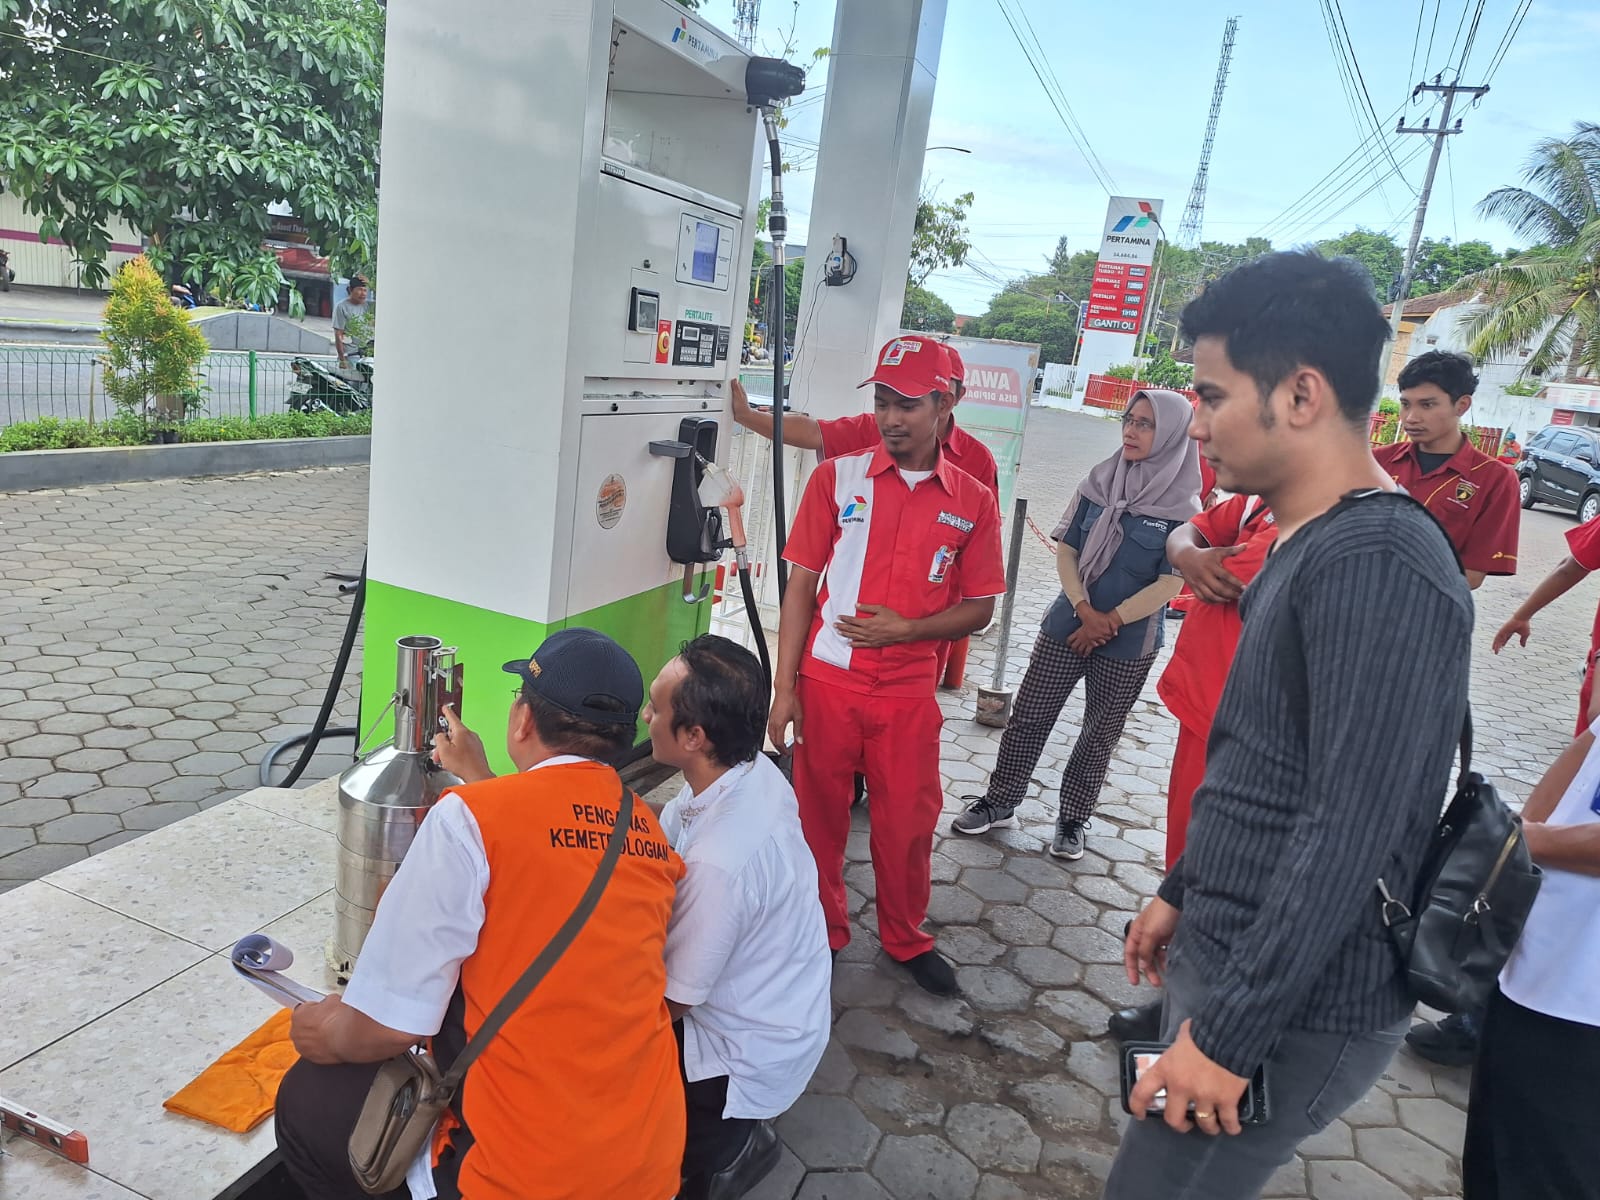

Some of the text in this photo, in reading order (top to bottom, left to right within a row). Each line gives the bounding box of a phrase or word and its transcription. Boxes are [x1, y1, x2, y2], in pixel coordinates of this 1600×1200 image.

[1106, 235, 1151, 246] PERTAMINA
[685, 309, 713, 321] PERTALITE
[1095, 319, 1135, 330] GANTI OLI
[572, 803, 651, 835] PENGAS
[549, 828, 670, 864] KEMETOLOGIAN
